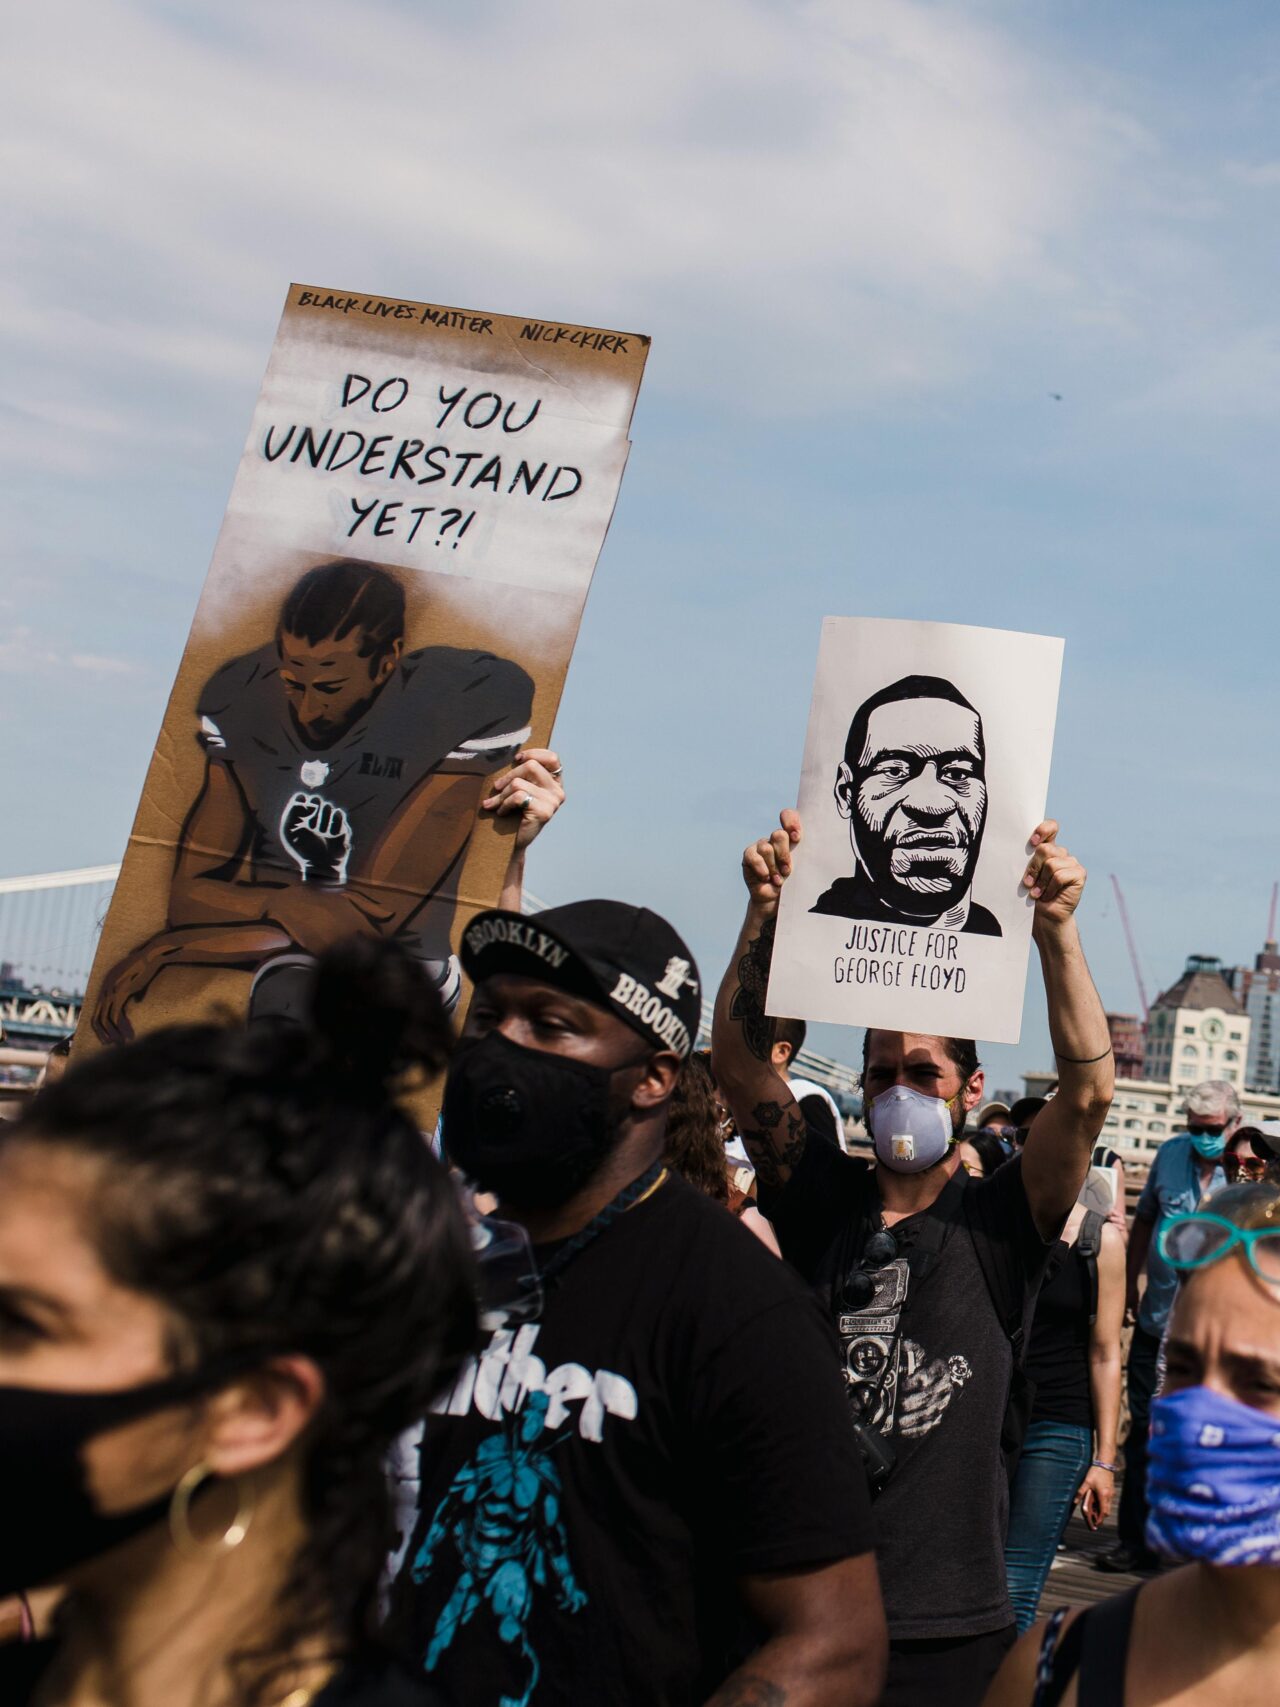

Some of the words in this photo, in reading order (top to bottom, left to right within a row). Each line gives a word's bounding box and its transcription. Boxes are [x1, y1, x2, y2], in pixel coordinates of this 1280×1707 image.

[340, 374, 409, 413] DO
[437, 385, 542, 433] YOU
[264, 425, 582, 501] UNDERSTAND
[346, 498, 477, 550] YET?!
[465, 918, 571, 969] BROOKLYN
[845, 925, 918, 957] JUSTICE
[925, 933, 959, 961] FOR
[834, 956, 904, 987] GEORGE
[911, 964, 967, 993] FLOYD
[609, 972, 690, 1060] BROOKLY
